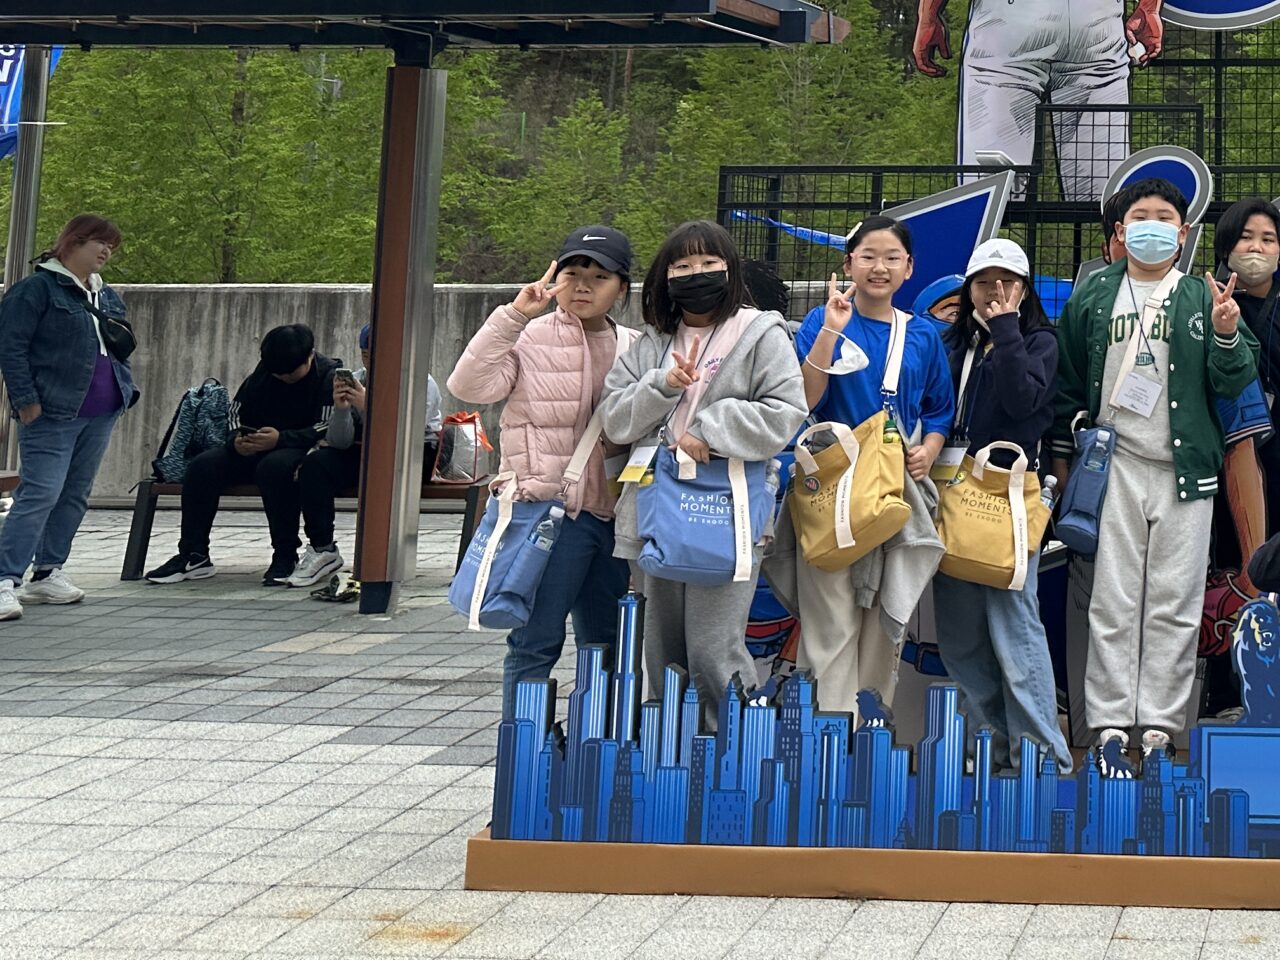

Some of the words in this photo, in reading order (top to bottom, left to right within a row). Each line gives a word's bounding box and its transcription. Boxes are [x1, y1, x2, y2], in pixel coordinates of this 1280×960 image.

[681, 492, 734, 505] FASHIO
[964, 488, 1011, 507] FASHIO
[680, 502, 732, 515] MOMENT
